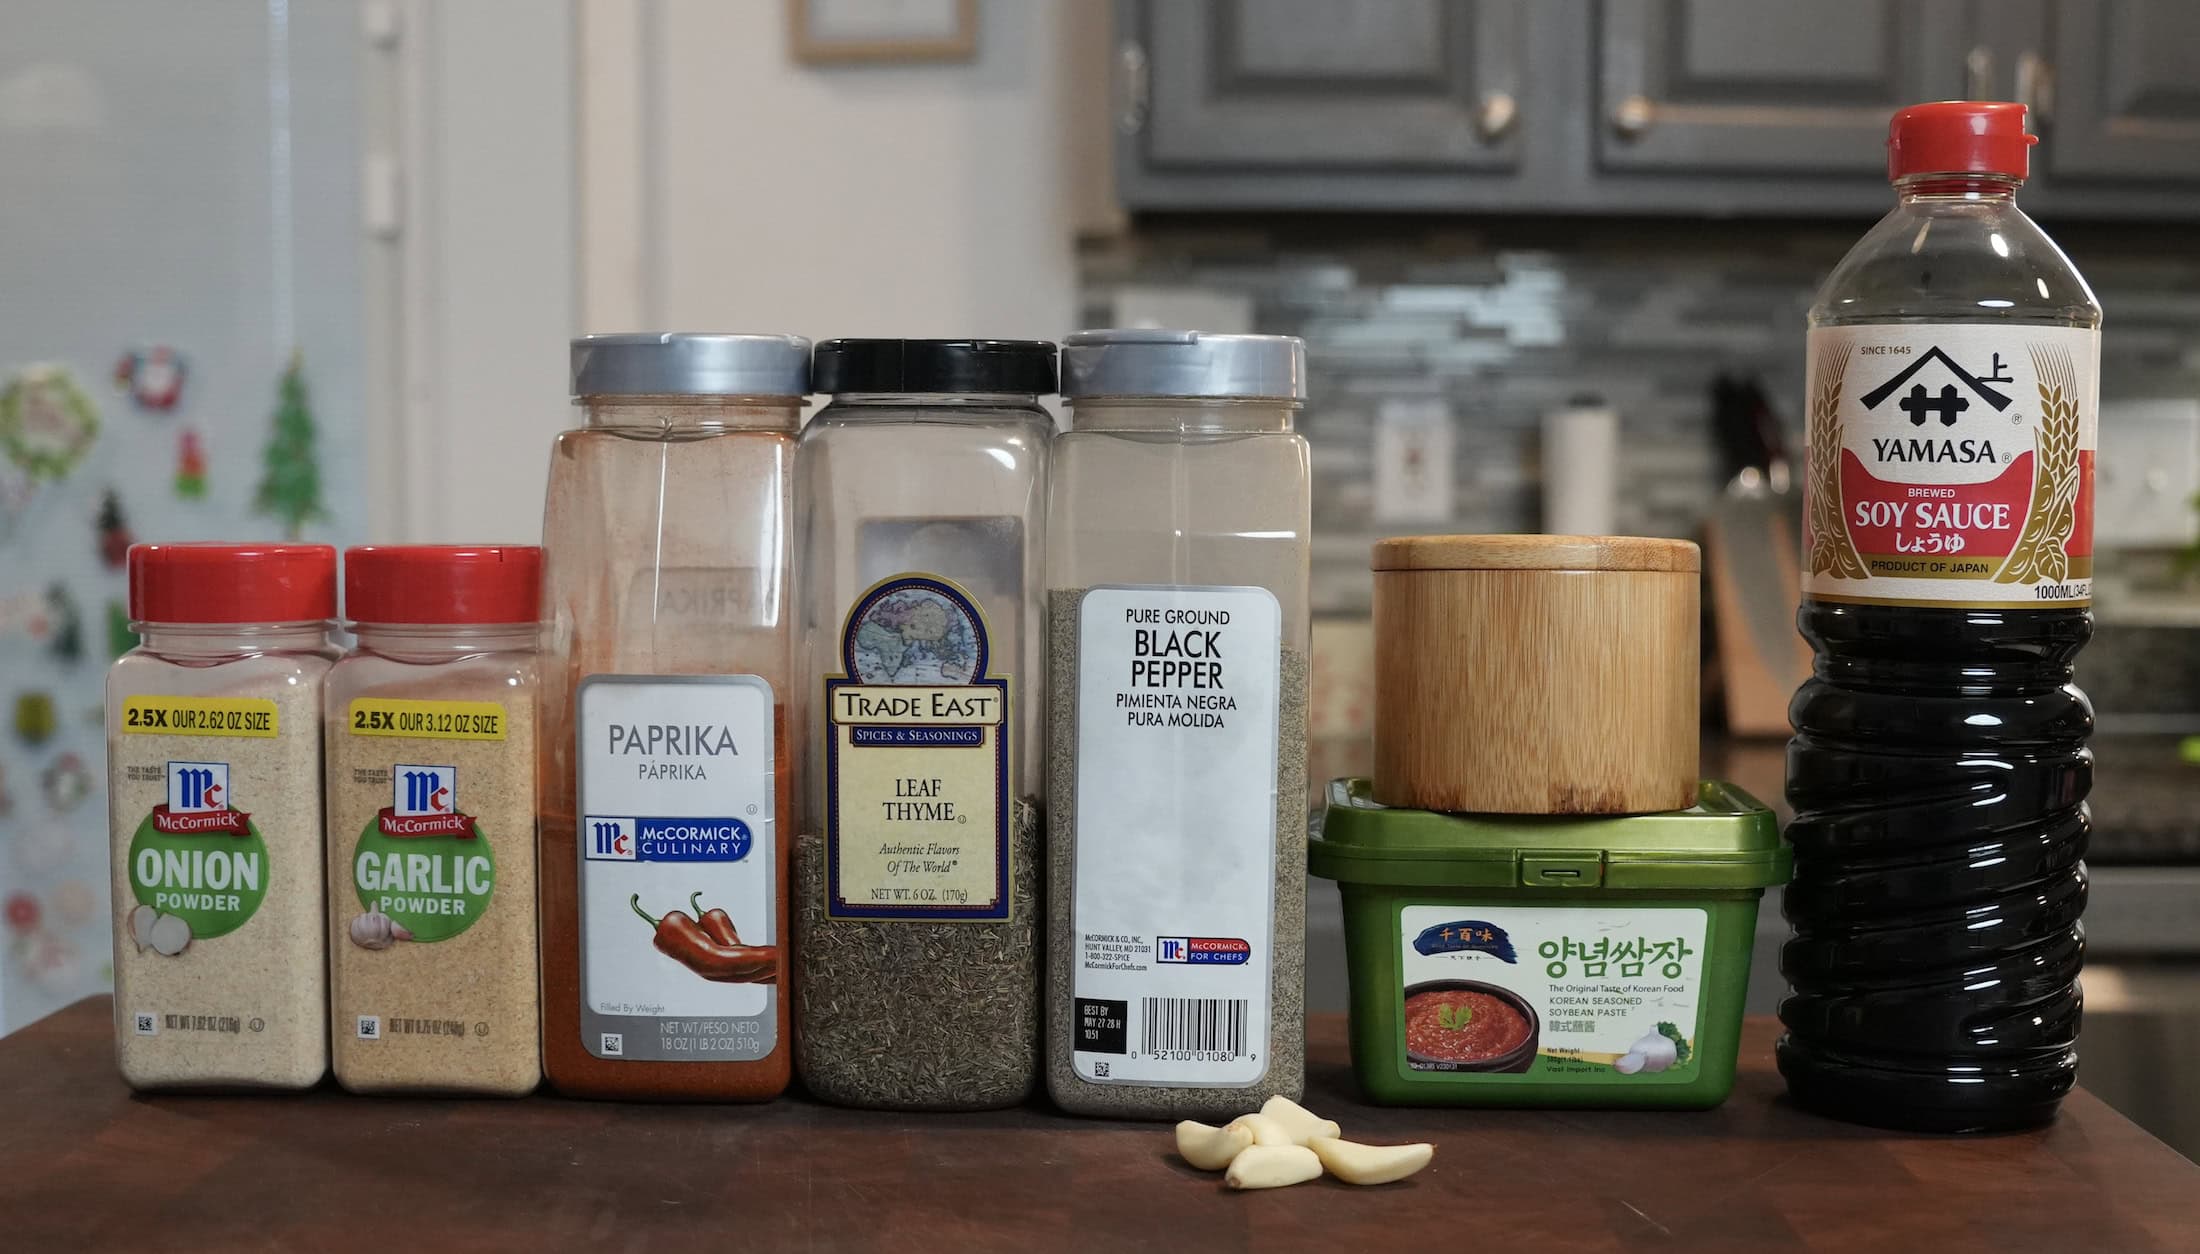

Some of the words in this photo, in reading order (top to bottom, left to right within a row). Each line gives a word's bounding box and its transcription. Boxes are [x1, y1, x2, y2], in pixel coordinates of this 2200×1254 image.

[1861, 346, 1886, 355] SINCE
[1888, 346, 1911, 355] 1645
[1872, 438, 1996, 463] YAMASA
[1908, 488, 1955, 498] BREWED
[1855, 501, 1909, 527] SOY
[1915, 502, 2010, 529] SAUCE
[1896, 532, 1965, 554] しょうゆ
[1871, 561, 1926, 572] PRODUCT
[1930, 562, 1947, 572] OF
[1950, 563, 1989, 574] JAPAN
[1126, 609, 1160, 624] PURE
[1165, 610, 1230, 625] GROUND
[1135, 629, 1222, 658] BLACK
[1131, 660, 1224, 689] PEPPER
[839, 693, 921, 717] TRADE
[931, 693, 992, 717] EAST
[1116, 693, 1182, 709] PIMIENTA
[1187, 695, 1237, 711] NEGRA
[128, 708, 168, 727] 2.5X
[172, 710, 196, 728] OUR
[199, 711, 224, 729] 2.62
[227, 712, 242, 729] OZ
[244, 712, 270, 730] SIZE
[354, 711, 394, 730] 2.5X
[400, 712, 423, 730] OUR
[426, 713, 451, 732] 3.12
[454, 714, 469, 733] OZ
[472, 715, 498, 734] SIZE
[1128, 711, 1164, 727] PURA
[1167, 713, 1224, 728] MOLIDA
[608, 725, 739, 756] PAPRIKA
[856, 729, 893, 741] SPICES
[896, 732, 906, 741] &
[908, 729, 978, 741] SEASONINGS
[639, 760, 707, 780] PÁPRIKA
[896, 779, 941, 797] LEAF
[882, 802, 955, 821] THYME
[158, 812, 239, 830] McCormick
[383, 815, 464, 833] McCormick
[642, 826, 741, 840] McCORMICK
[642, 843, 741, 854] CULINARY
[879, 843, 924, 855] Authentic
[926, 843, 960, 855] Flavors
[137, 848, 258, 890] ONION
[356, 851, 491, 895] GARLIC
[887, 860, 901, 876] Of
[903, 860, 920, 873] The
[923, 860, 950, 873] World
[156, 892, 240, 911] POWDER
[871, 888, 892, 900] NET
[893, 888, 911, 900] WT.
[913, 888, 918, 900] 6
[942, 889, 968, 904] (170g)
[381, 896, 466, 915] POWDER
[1085, 943, 1101, 951] HUNT
[1134, 945, 1151, 953] 21031
[1190, 952, 1208, 960] FOR
[1213, 953, 1243, 961] CHEFS
[1538, 936, 1694, 979] 양념쌈장
[1085, 961, 1147, 971] McCormickForChefs.com
[1549, 984, 1564, 993] The
[1566, 985, 1599, 994] Original
[1600, 985, 1621, 993] Taste
[1623, 985, 1632, 993] of
[1633, 985, 1661, 993] Korean
[1663, 985, 1684, 993] Food
[600, 1003, 620, 1012] Filled
[624, 1004, 633, 1014] By
[635, 1004, 665, 1015] Weight
[1549, 997, 1588, 1005] KOREAN
[1592, 997, 1643, 1005] SEASONED
[1084, 1005, 1099, 1015] BEST
[1100, 1006, 1109, 1016] BY
[1549, 1008, 1594, 1017] SOYBEAN
[1598, 1009, 1627, 1017] PASTE
[660, 1022, 680, 1034] NET
[681, 1022, 728, 1035] WT/PESO
[731, 1021, 759, 1034] NETO
[1084, 1017, 1096, 1027] MAY
[1097, 1018, 1106, 1028] 27
[661, 1038, 672, 1050] 18
[674, 1038, 688, 1050] OZ
[700, 1038, 709, 1050] LB
[710, 1038, 716, 1050] 2
[718, 1038, 735, 1052] OZ)
[737, 1038, 760, 1053] 510g
[1251, 1054, 1256, 1062] 9
